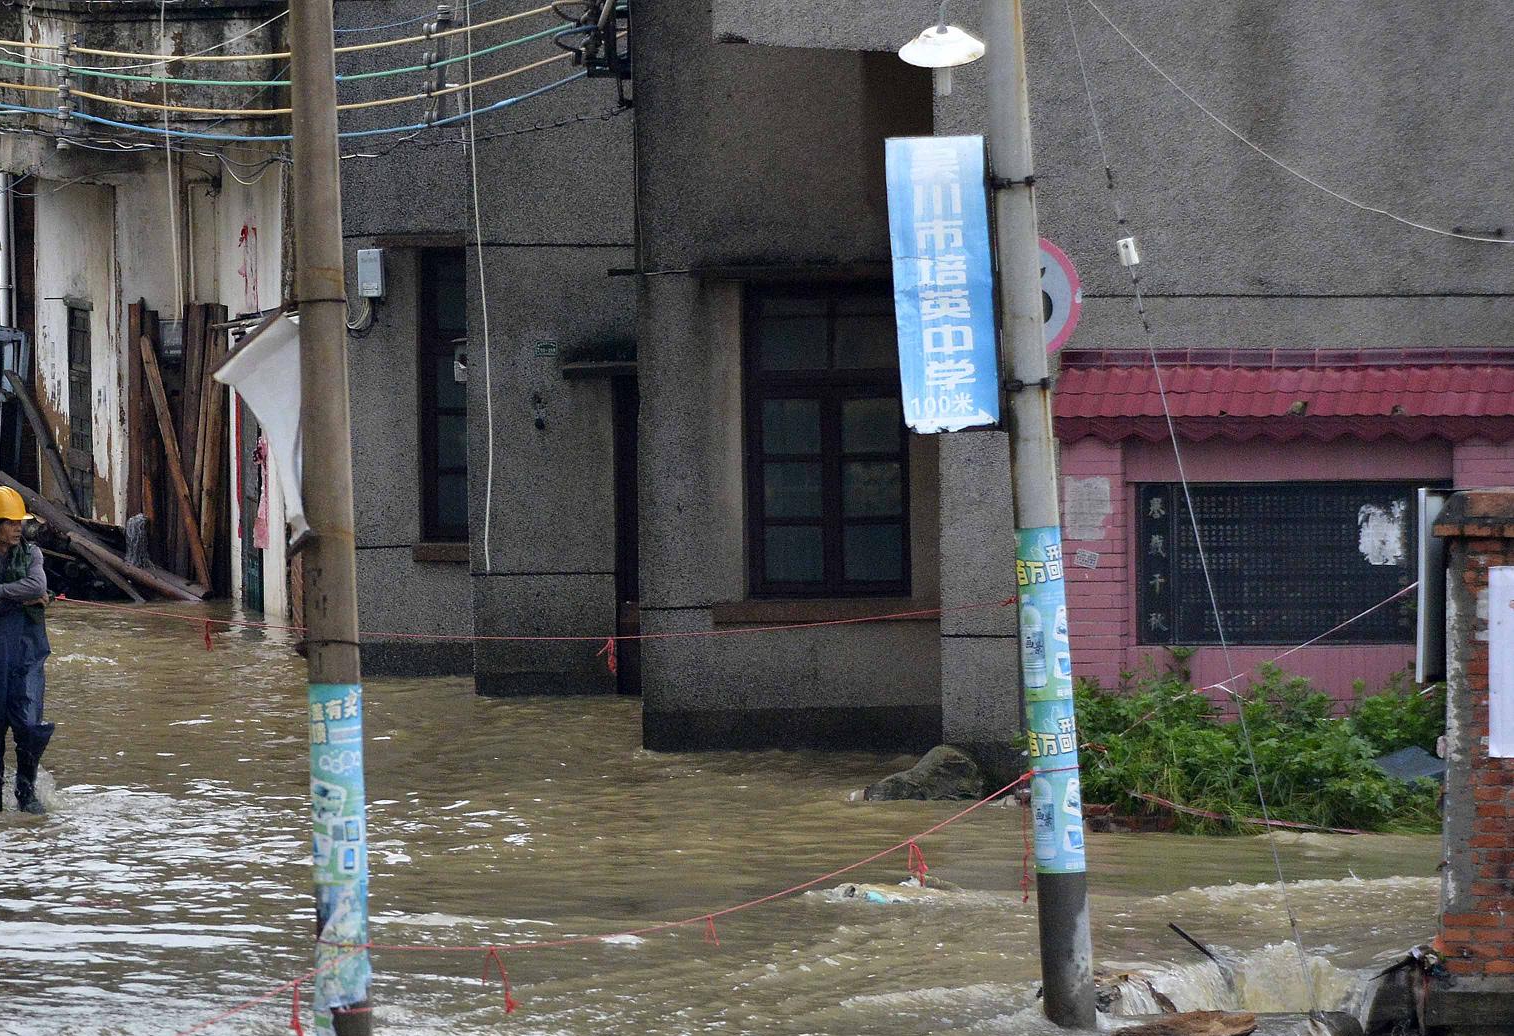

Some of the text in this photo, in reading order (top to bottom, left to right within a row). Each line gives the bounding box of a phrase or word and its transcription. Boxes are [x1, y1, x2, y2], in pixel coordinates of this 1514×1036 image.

[910, 391, 974, 417] 100米
[1016, 558, 1064, 586] 百万回
[1027, 730, 1078, 757] 百万回
